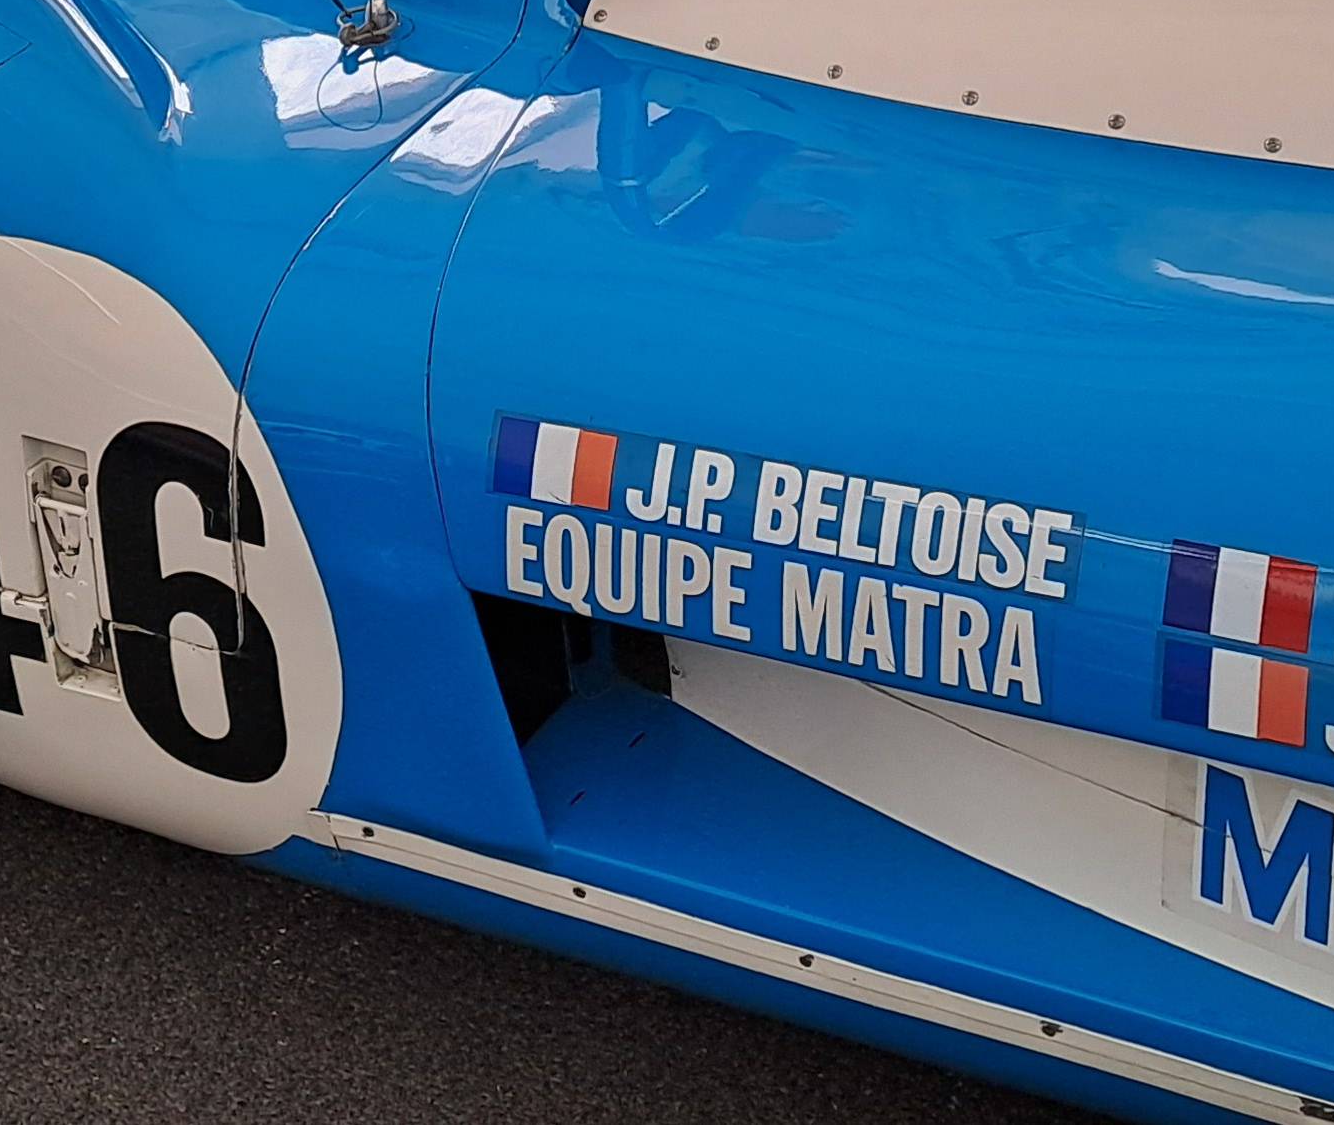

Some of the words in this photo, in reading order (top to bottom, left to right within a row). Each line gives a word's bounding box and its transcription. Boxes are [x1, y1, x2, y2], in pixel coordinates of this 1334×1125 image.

[506, 505, 752, 641] EQUIPE
[782, 560, 1042, 705] MATRA
[625, 443, 735, 533] J.P.
[753, 461, 1072, 599] BELTOISE
